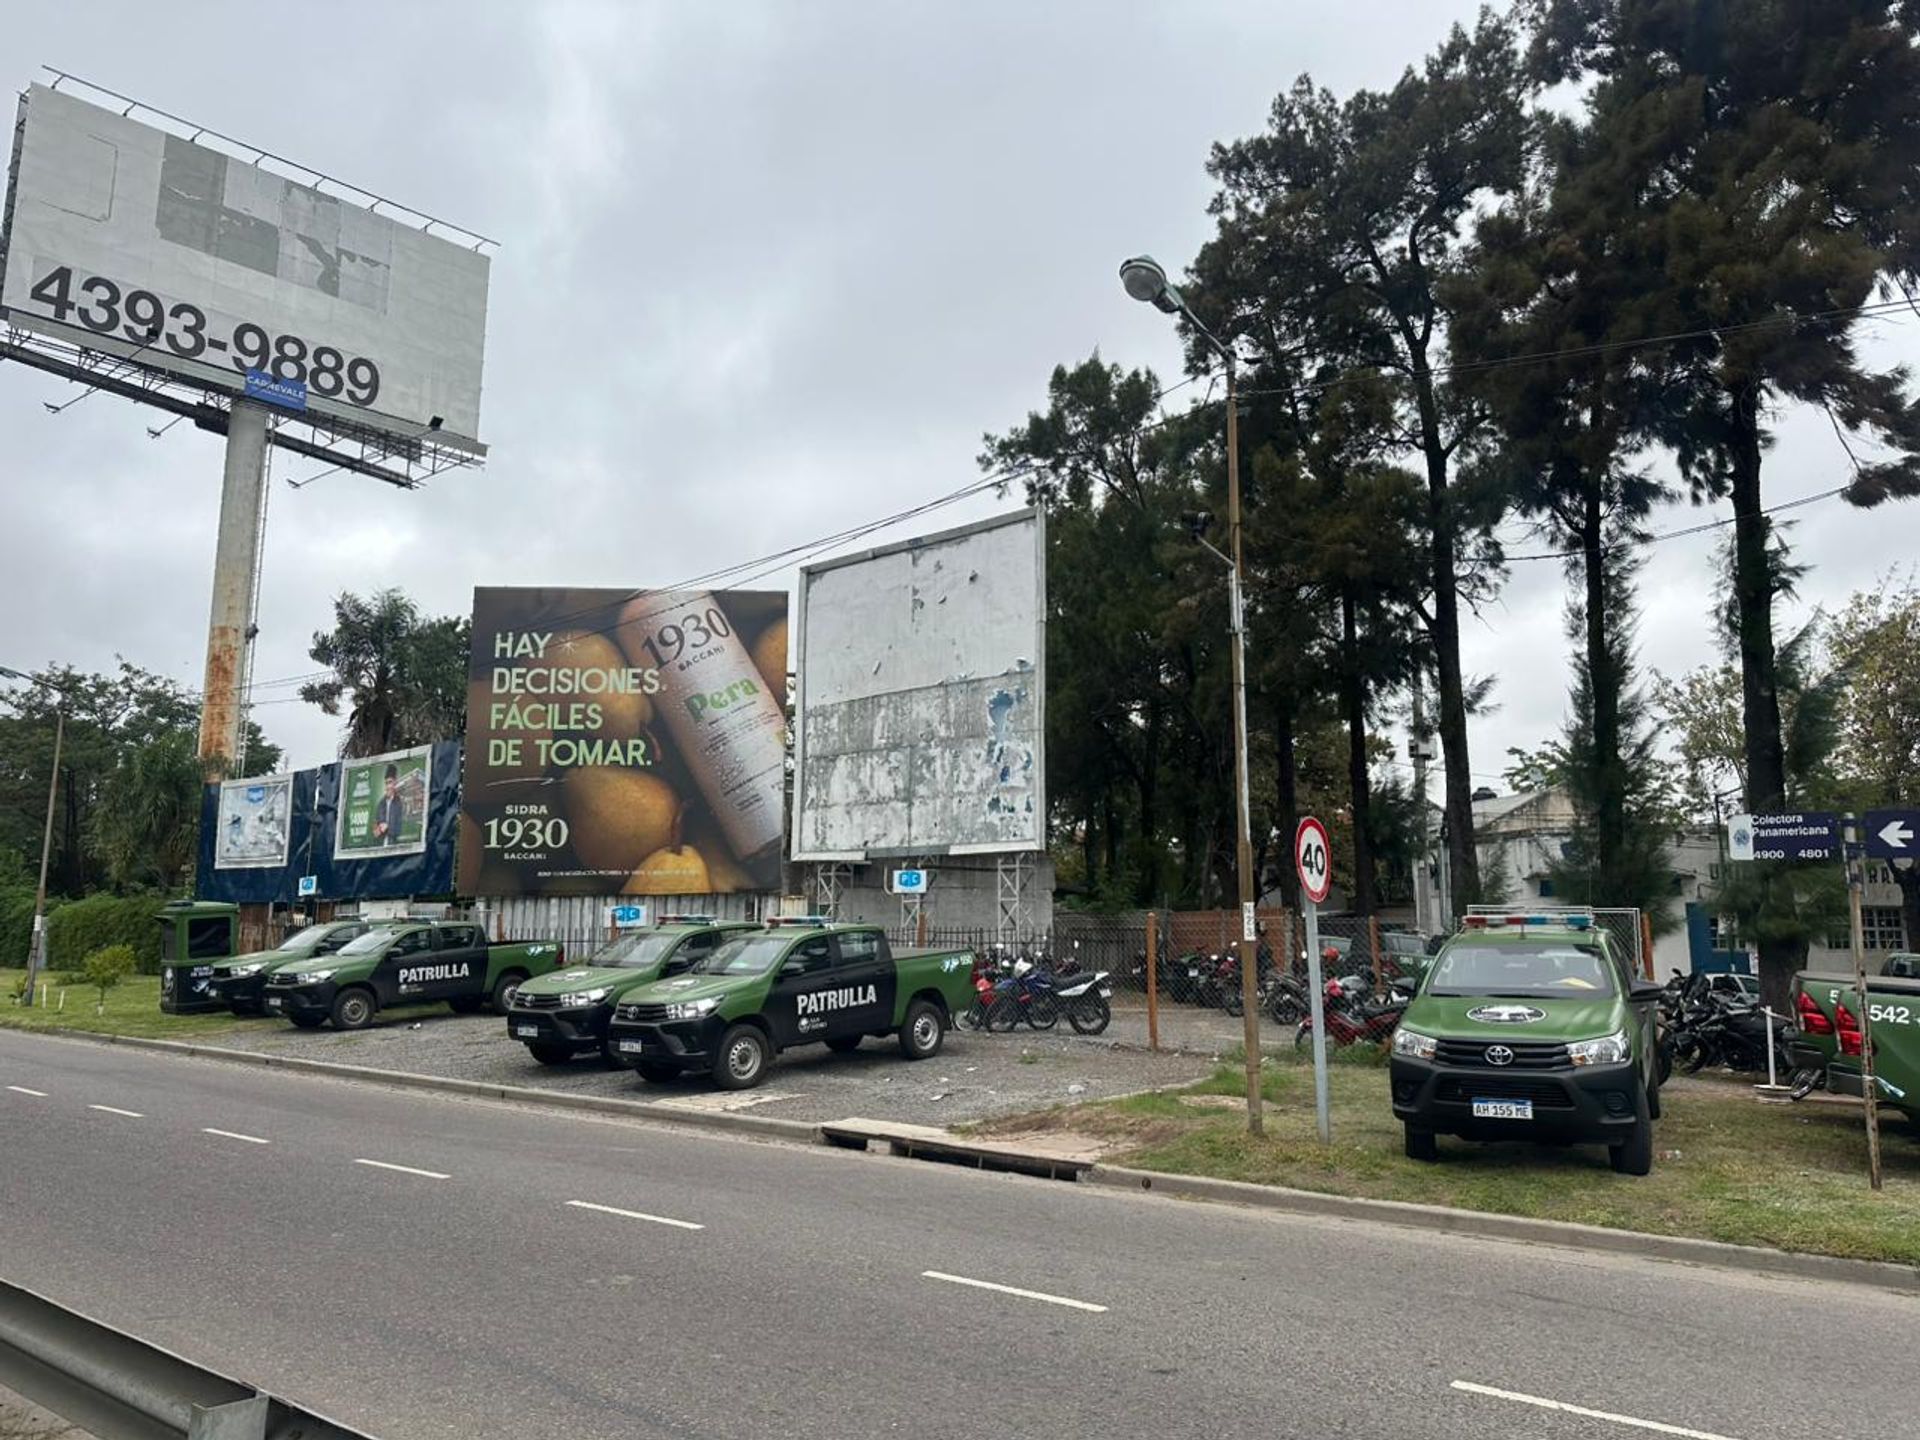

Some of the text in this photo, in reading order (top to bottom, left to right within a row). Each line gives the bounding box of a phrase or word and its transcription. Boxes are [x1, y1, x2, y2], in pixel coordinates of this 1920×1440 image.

[30, 264, 380, 406] 4393-9889
[494, 631, 552, 659] HAY
[642, 607, 731, 670] 1930
[492, 667, 667, 695] DECISIONES.
[490, 695, 603, 730] FÁCILES
[684, 677, 760, 722] Pera
[488, 739, 652, 766] DE TOMAR.
[505, 804, 549, 815] SIDRA
[1751, 814, 1803, 825] Colectora
[484, 818, 569, 849] 1930
[1752, 826, 1830, 837] Panamericana
[1302, 843, 1326, 876] 40
[1753, 849, 1829, 859] 4900 4801
[398, 962, 470, 983] PATRULLA
[797, 984, 877, 1015] PATRULLA
[1869, 1004, 1910, 1025] 542
[1492, 1105, 1514, 1117] 155
